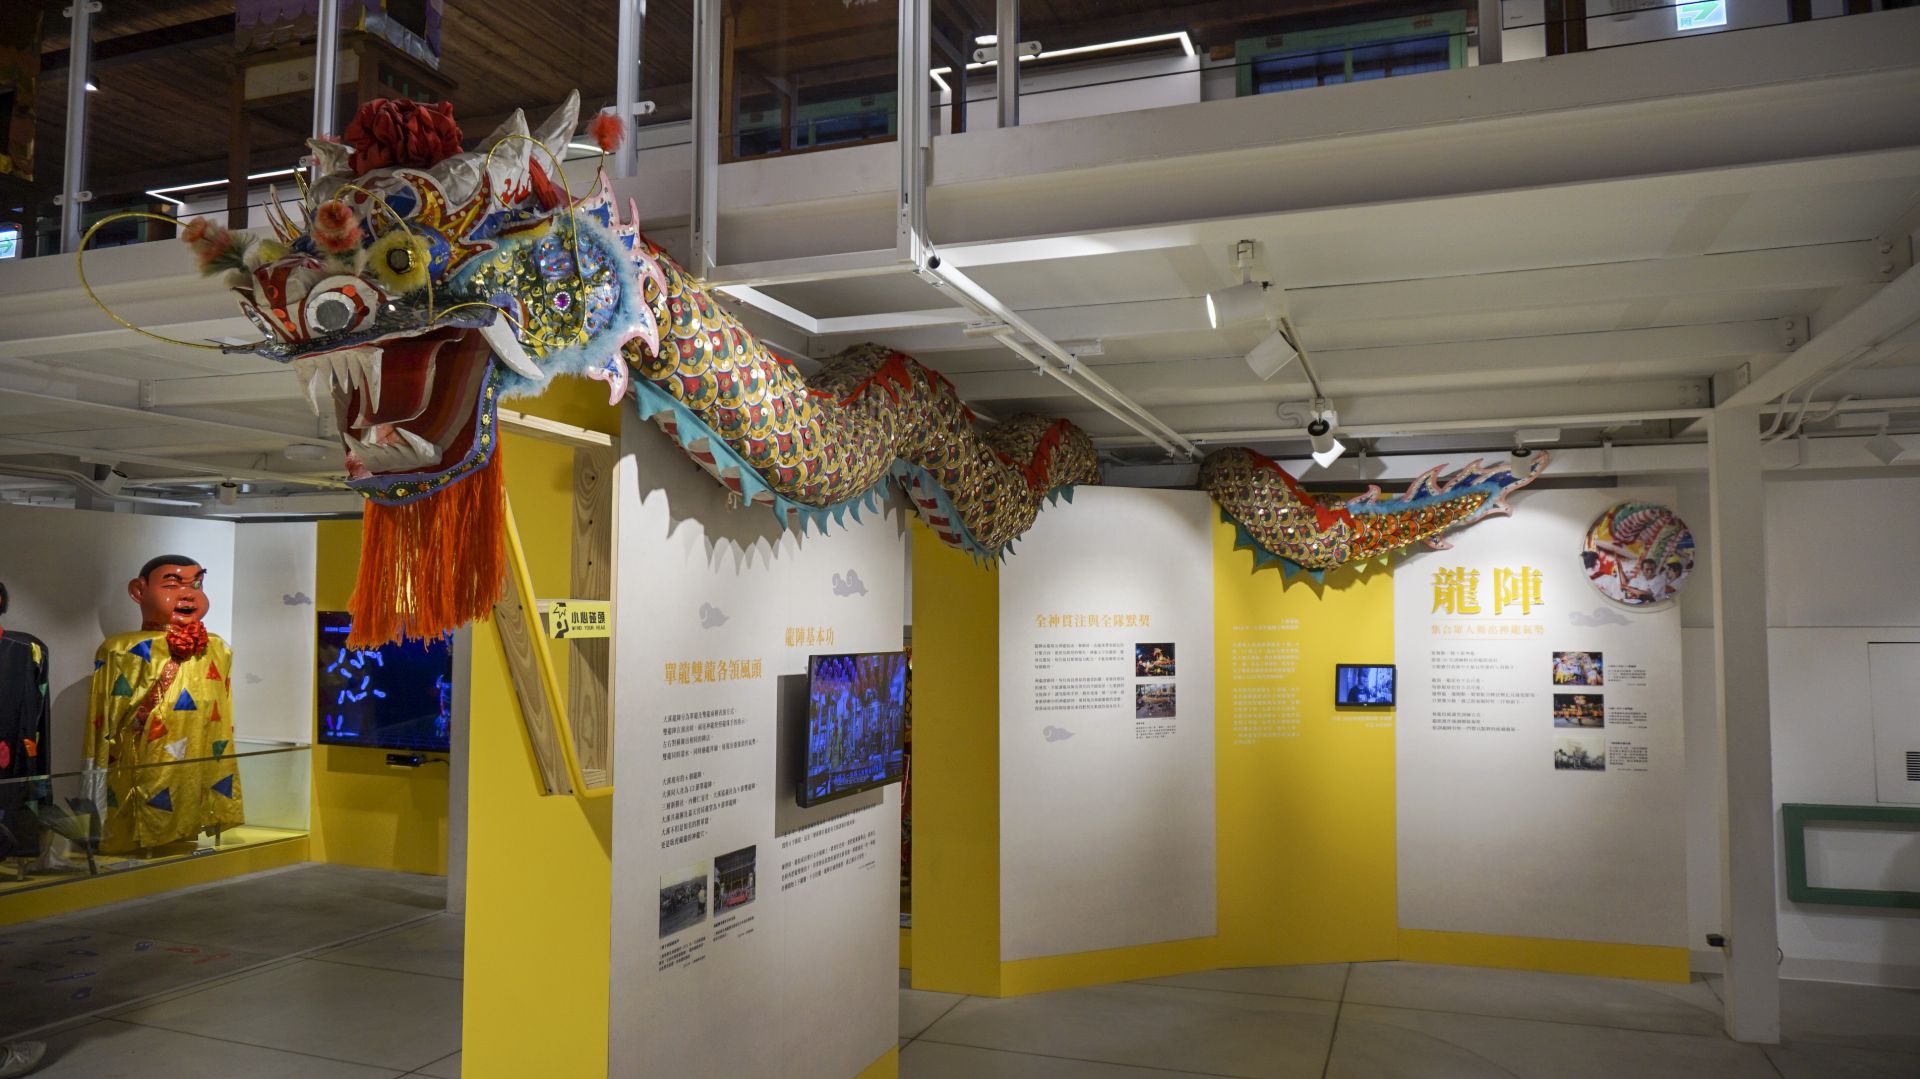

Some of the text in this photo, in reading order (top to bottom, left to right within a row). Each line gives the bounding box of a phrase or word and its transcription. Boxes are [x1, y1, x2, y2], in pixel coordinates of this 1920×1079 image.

[1431, 566, 1545, 616] 龍陣
[571, 611, 606, 624] 小心碰頭
[1036, 614, 1151, 628] 全神貫注與全隊默契
[785, 626, 834, 648] 龍陣基本功
[664, 658, 762, 685] 單龍雙龍各領風頭
